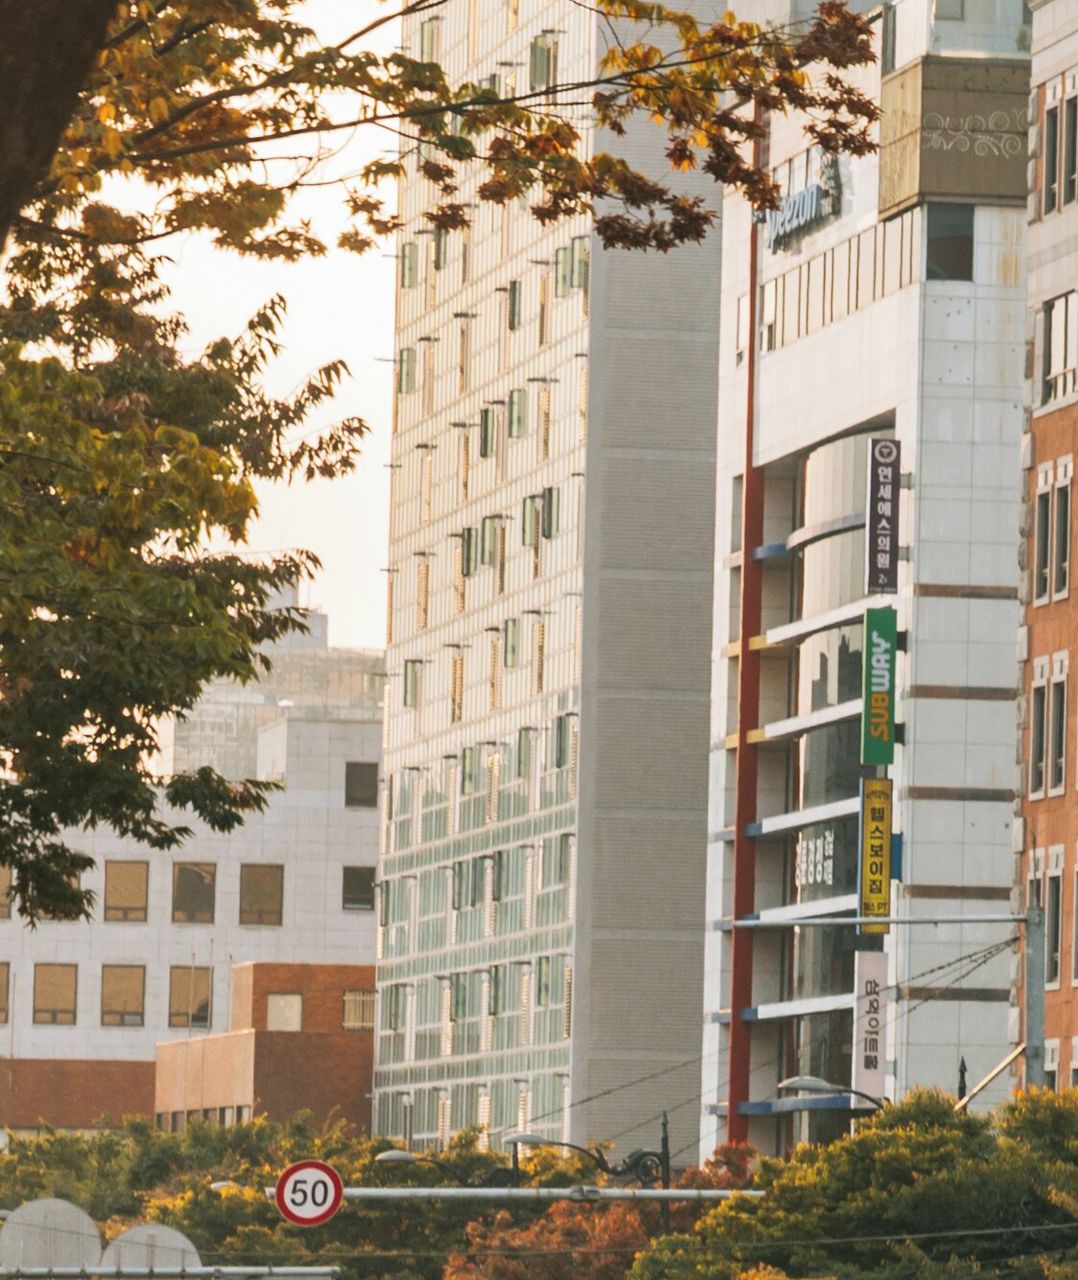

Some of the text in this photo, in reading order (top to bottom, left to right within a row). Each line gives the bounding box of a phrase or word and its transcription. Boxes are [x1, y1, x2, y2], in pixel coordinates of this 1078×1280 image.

[870, 629, 891, 743] SUBWAY
[869, 806, 886, 895] 헬스보이짐
[290, 1179, 329, 1207] 50
